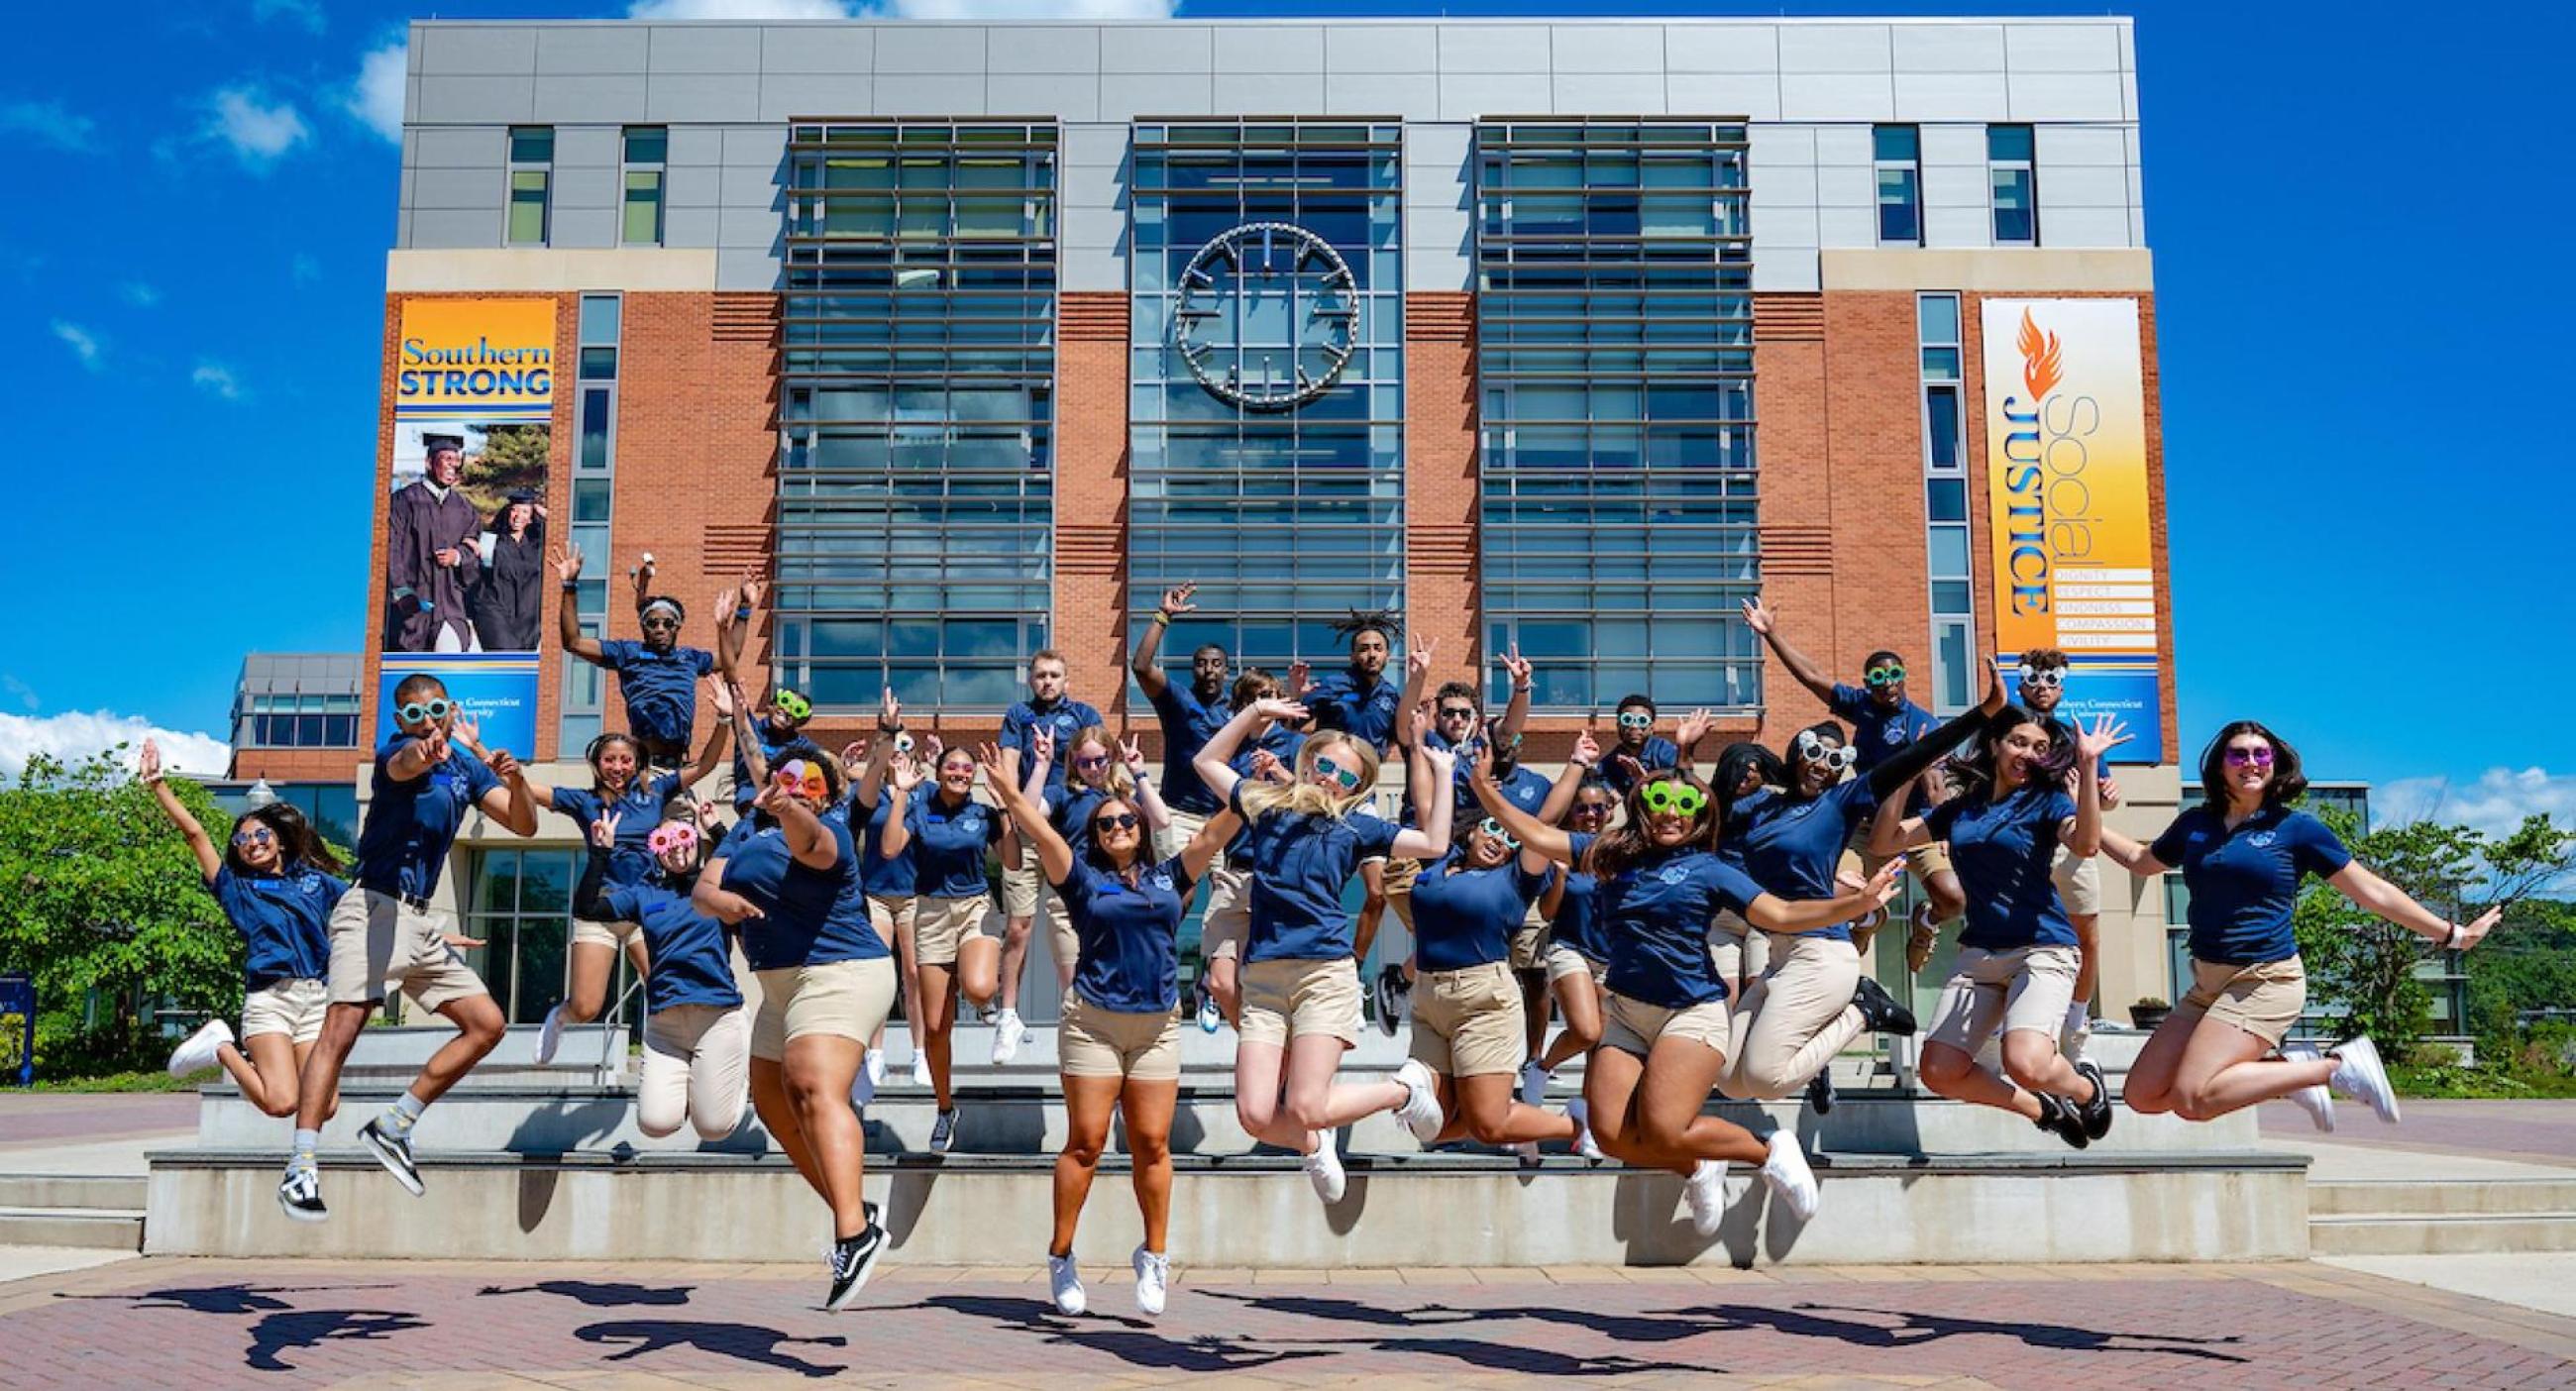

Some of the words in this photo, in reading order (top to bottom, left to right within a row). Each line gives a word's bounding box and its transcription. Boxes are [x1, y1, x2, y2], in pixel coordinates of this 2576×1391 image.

[402, 336, 551, 365] Southern
[399, 369, 551, 395] STRONG
[2045, 393, 2104, 566] Social
[2002, 395, 2049, 616] JUSTICE
[2055, 570, 2108, 581] DIGNITY
[2056, 586, 2111, 596] RESPECT
[2058, 602, 2123, 613] KINDNESS
[2058, 618, 2147, 630] COMPASSION
[2059, 635, 2111, 647] CIVILITY
[466, 696, 520, 706] Connecticut
[2088, 697, 2144, 709] Connecticut
